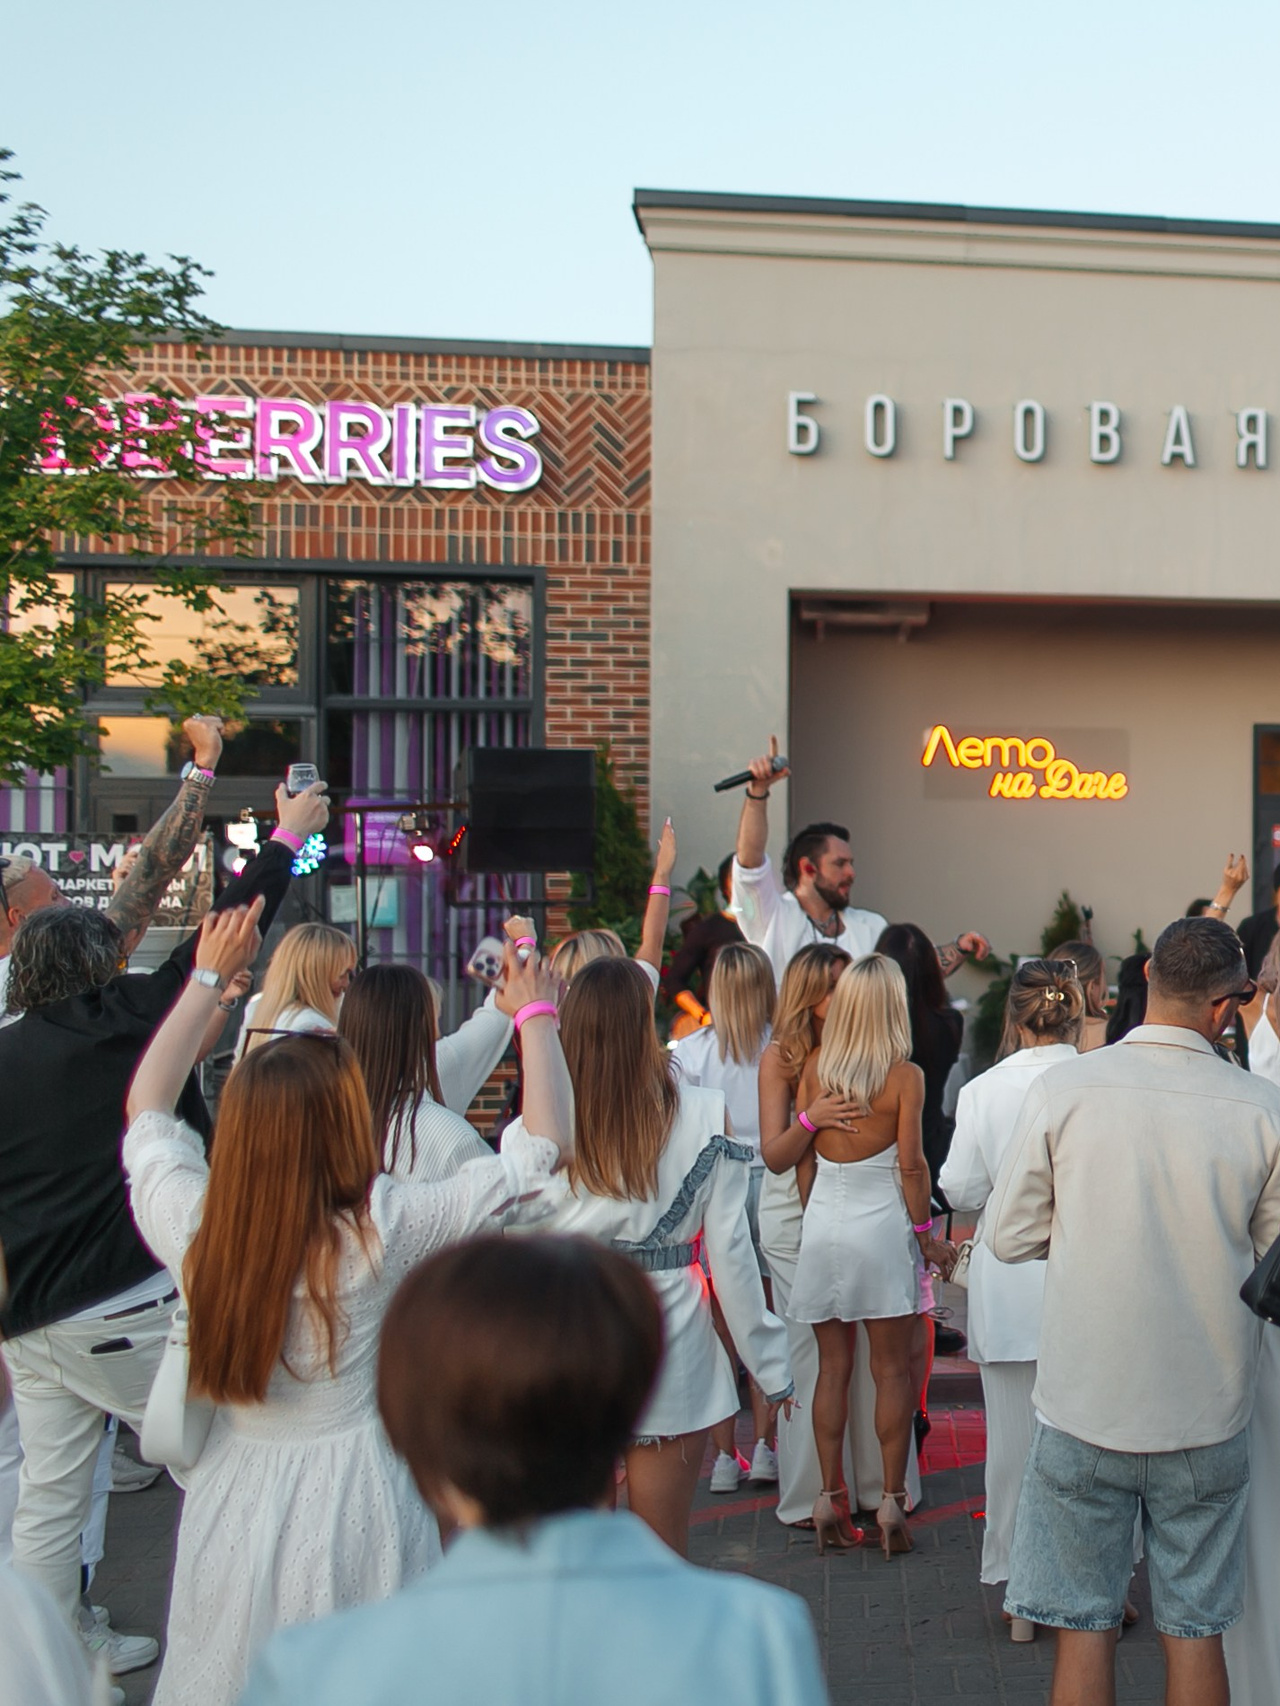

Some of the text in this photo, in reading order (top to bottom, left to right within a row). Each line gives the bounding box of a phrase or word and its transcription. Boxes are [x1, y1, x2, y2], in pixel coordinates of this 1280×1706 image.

[786, 390, 1269, 470] БОРОВАЯ
[921, 724, 1056, 769] Лето
[989, 758, 1128, 799] на Даче
[90, 843, 208, 873] МЛ
